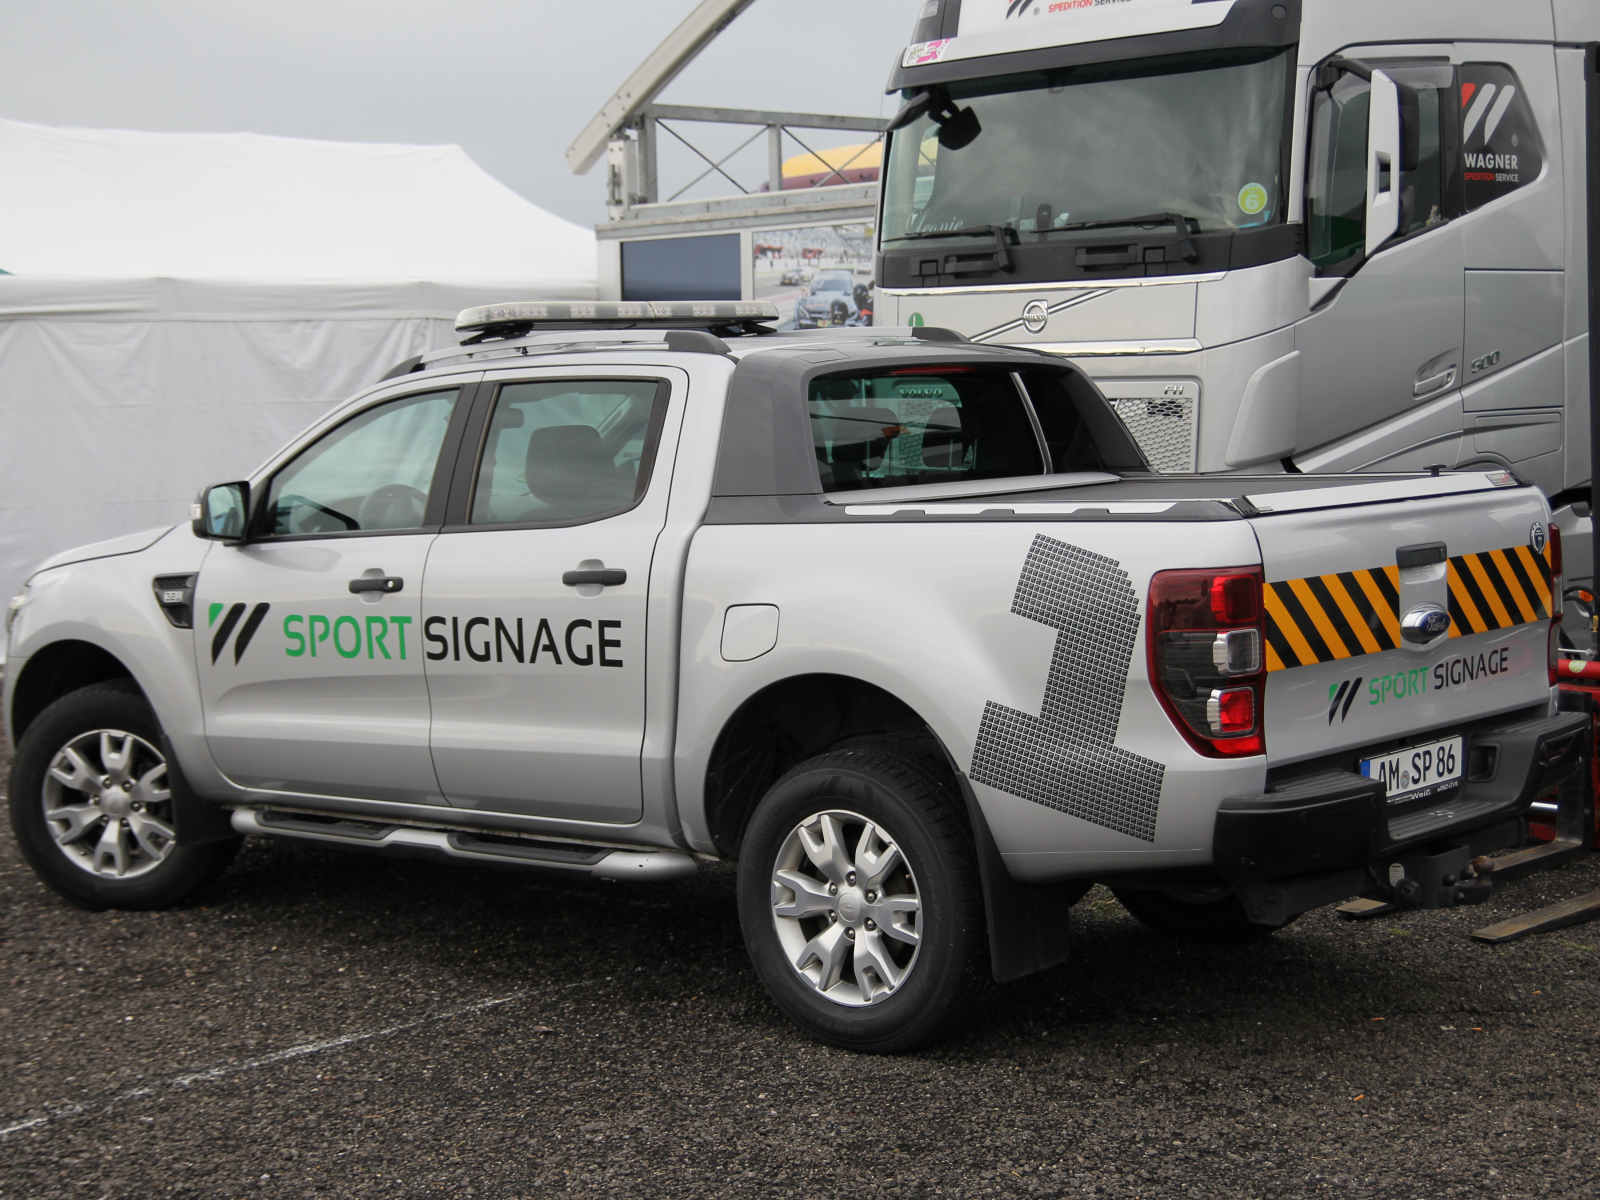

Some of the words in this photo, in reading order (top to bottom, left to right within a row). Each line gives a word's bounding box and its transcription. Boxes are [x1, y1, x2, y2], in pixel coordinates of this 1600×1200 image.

[1047, 0, 1093, 13] SPEDITION
[1463, 153, 1519, 170] WAGNER
[1464, 172, 1495, 181] SPEDITION
[1495, 173, 1519, 182] SERVICE
[1245, 193, 1260, 210] 6
[1024, 314, 1046, 322] VOLVO
[1471, 350, 1500, 374] 500
[899, 388, 943, 399] VOLVO
[1164, 384, 1184, 395] FH
[1426, 615, 1446, 631] Ford
[283, 614, 412, 660] SPORT
[424, 616, 624, 667] SIGNAGE
[1369, 666, 1430, 706] SPORT
[1434, 646, 1509, 691] SIGNAGE
[1378, 758, 1400, 792] AM
[1411, 750, 1432, 785] SP
[1436, 743, 1455, 778] 86
